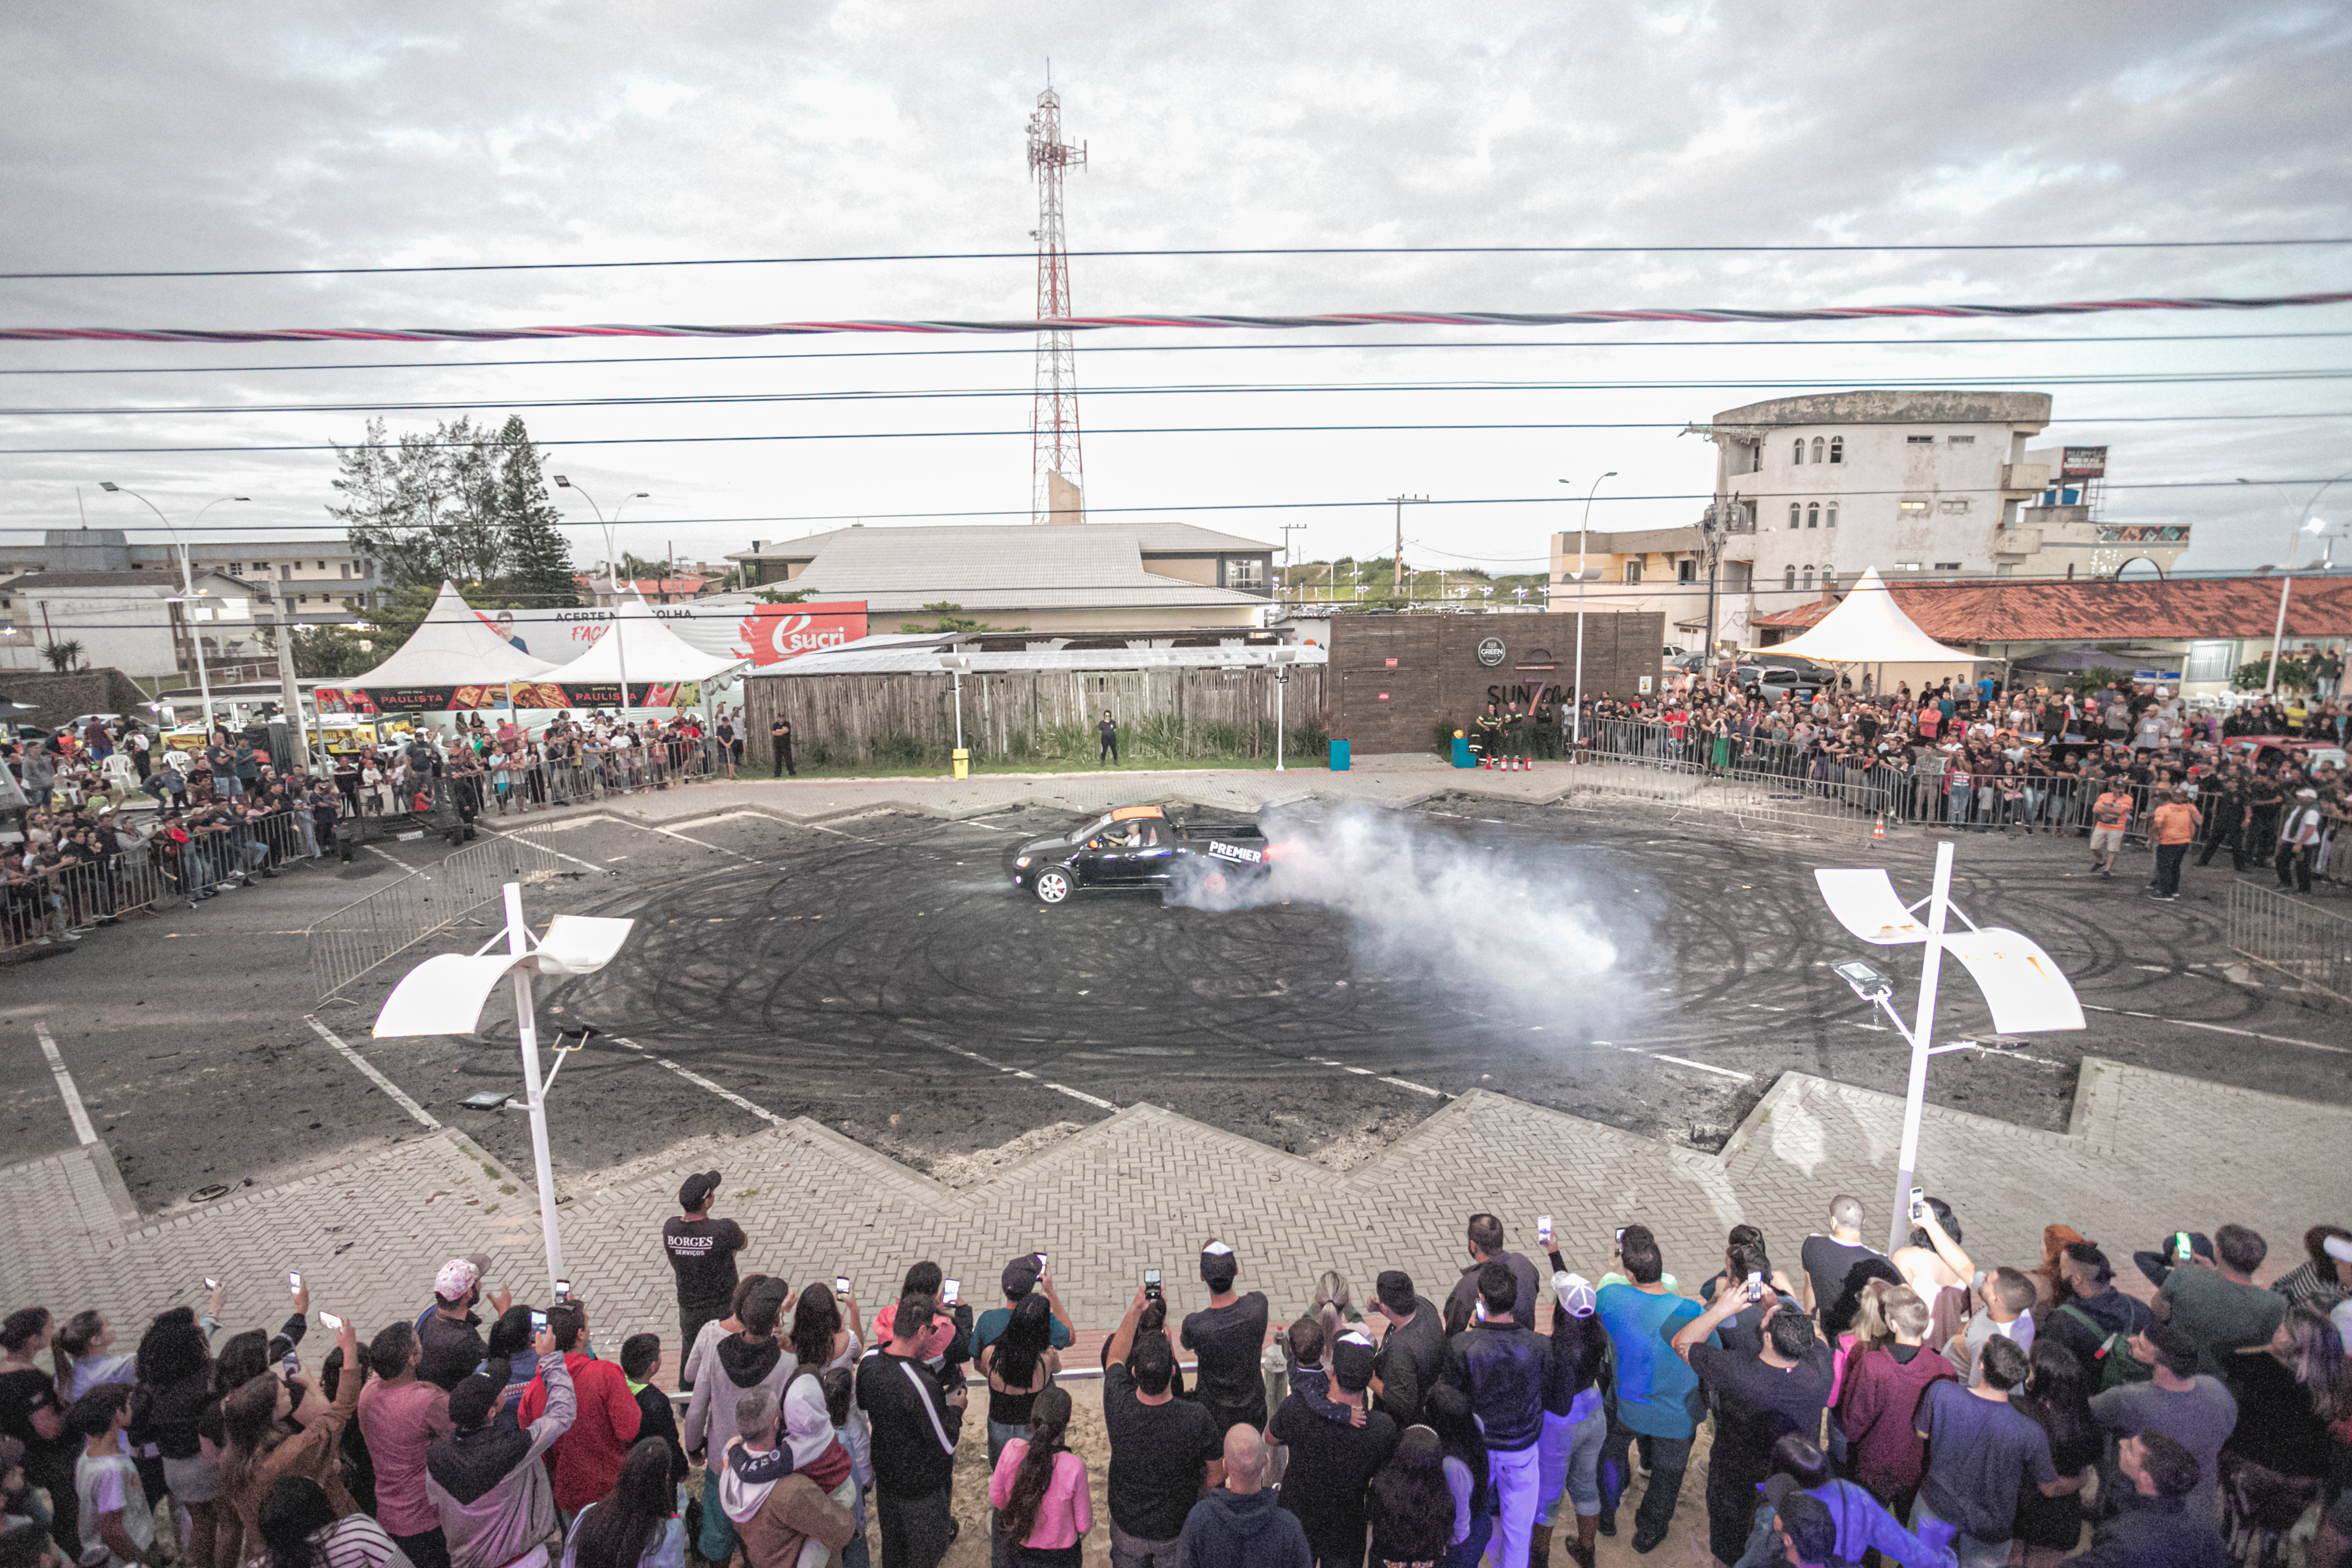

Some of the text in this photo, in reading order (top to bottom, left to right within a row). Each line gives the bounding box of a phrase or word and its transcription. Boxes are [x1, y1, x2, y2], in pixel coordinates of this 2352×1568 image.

[556, 611, 605, 622] ACERTE
[381, 695, 443, 704] PAULISTA
[576, 693, 637, 701] PAULISA
[1487, 685, 1530, 705] SUN
[1525, 678, 1547, 716] 7
[1209, 841, 1262, 863] PREMIER
[667, 1236, 713, 1247] BORGES
